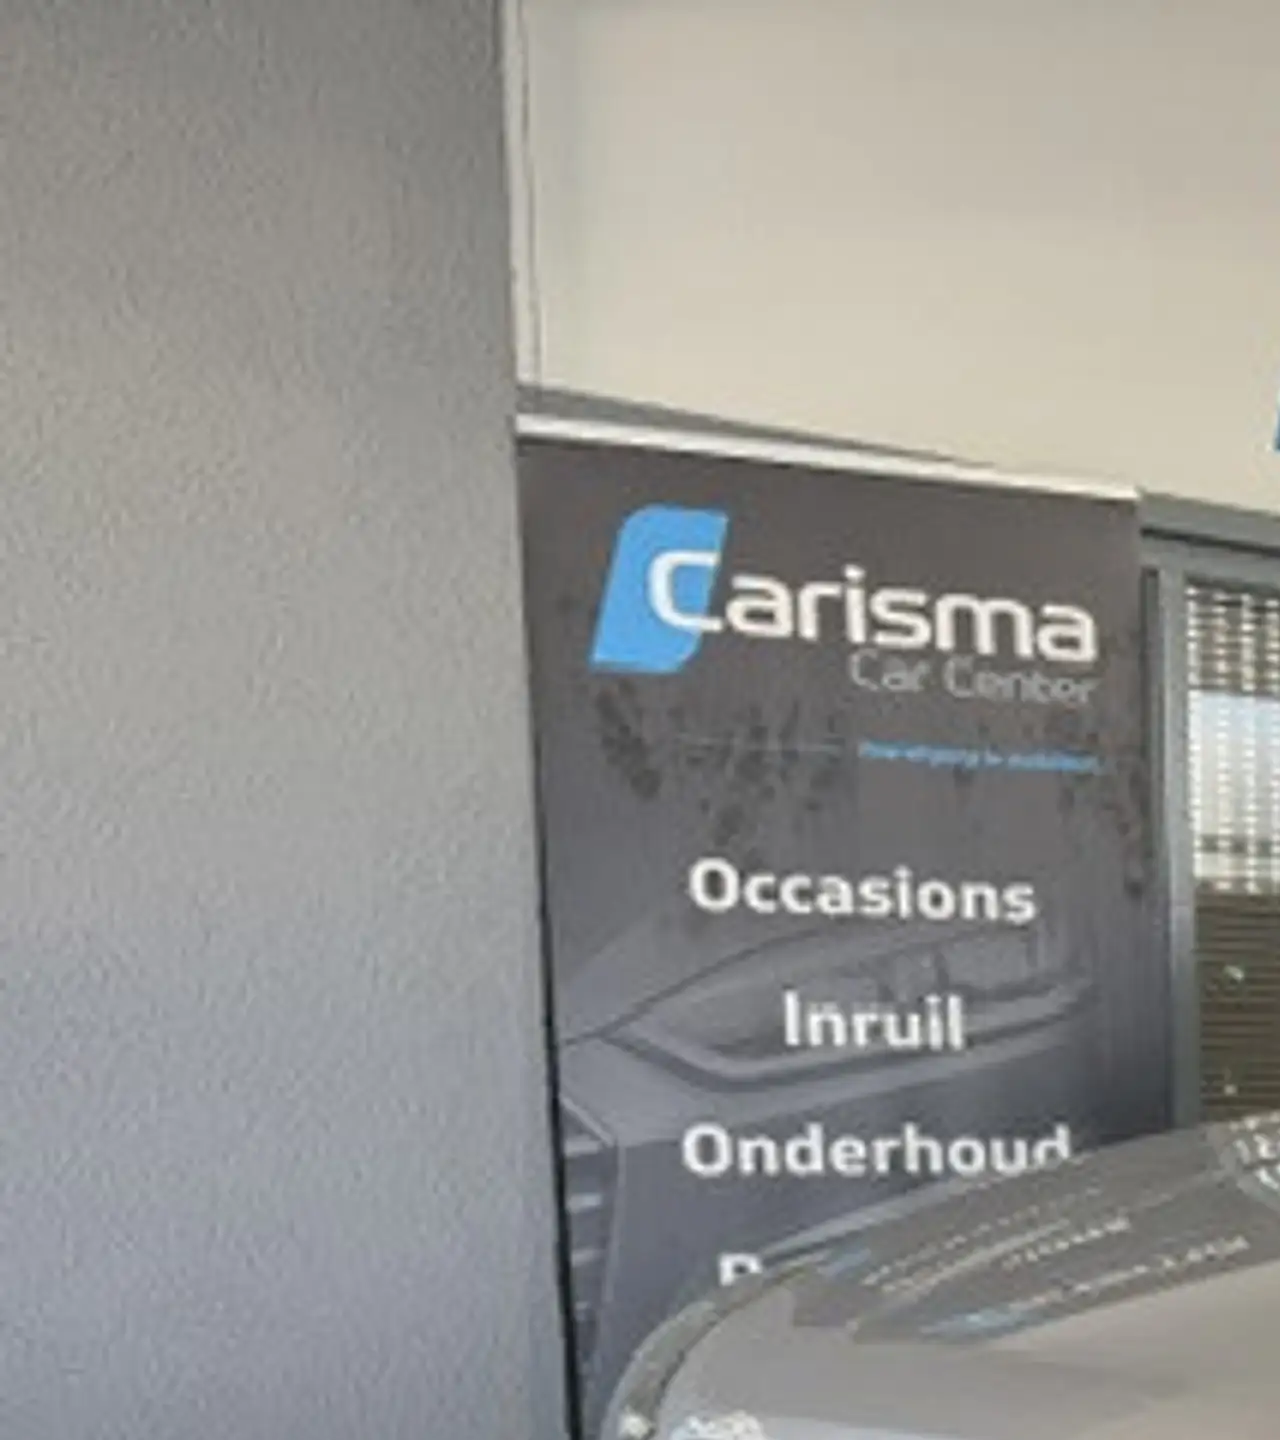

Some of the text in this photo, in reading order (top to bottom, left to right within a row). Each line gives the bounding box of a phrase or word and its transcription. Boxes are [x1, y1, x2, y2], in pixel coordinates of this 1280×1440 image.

[647, 548, 1098, 664] Carisma
[848, 646, 1101, 705] Car Center
[687, 856, 1037, 924] Occasions
[782, 988, 965, 1051] Inruil
[681, 1122, 1071, 1178] Onderhoud
